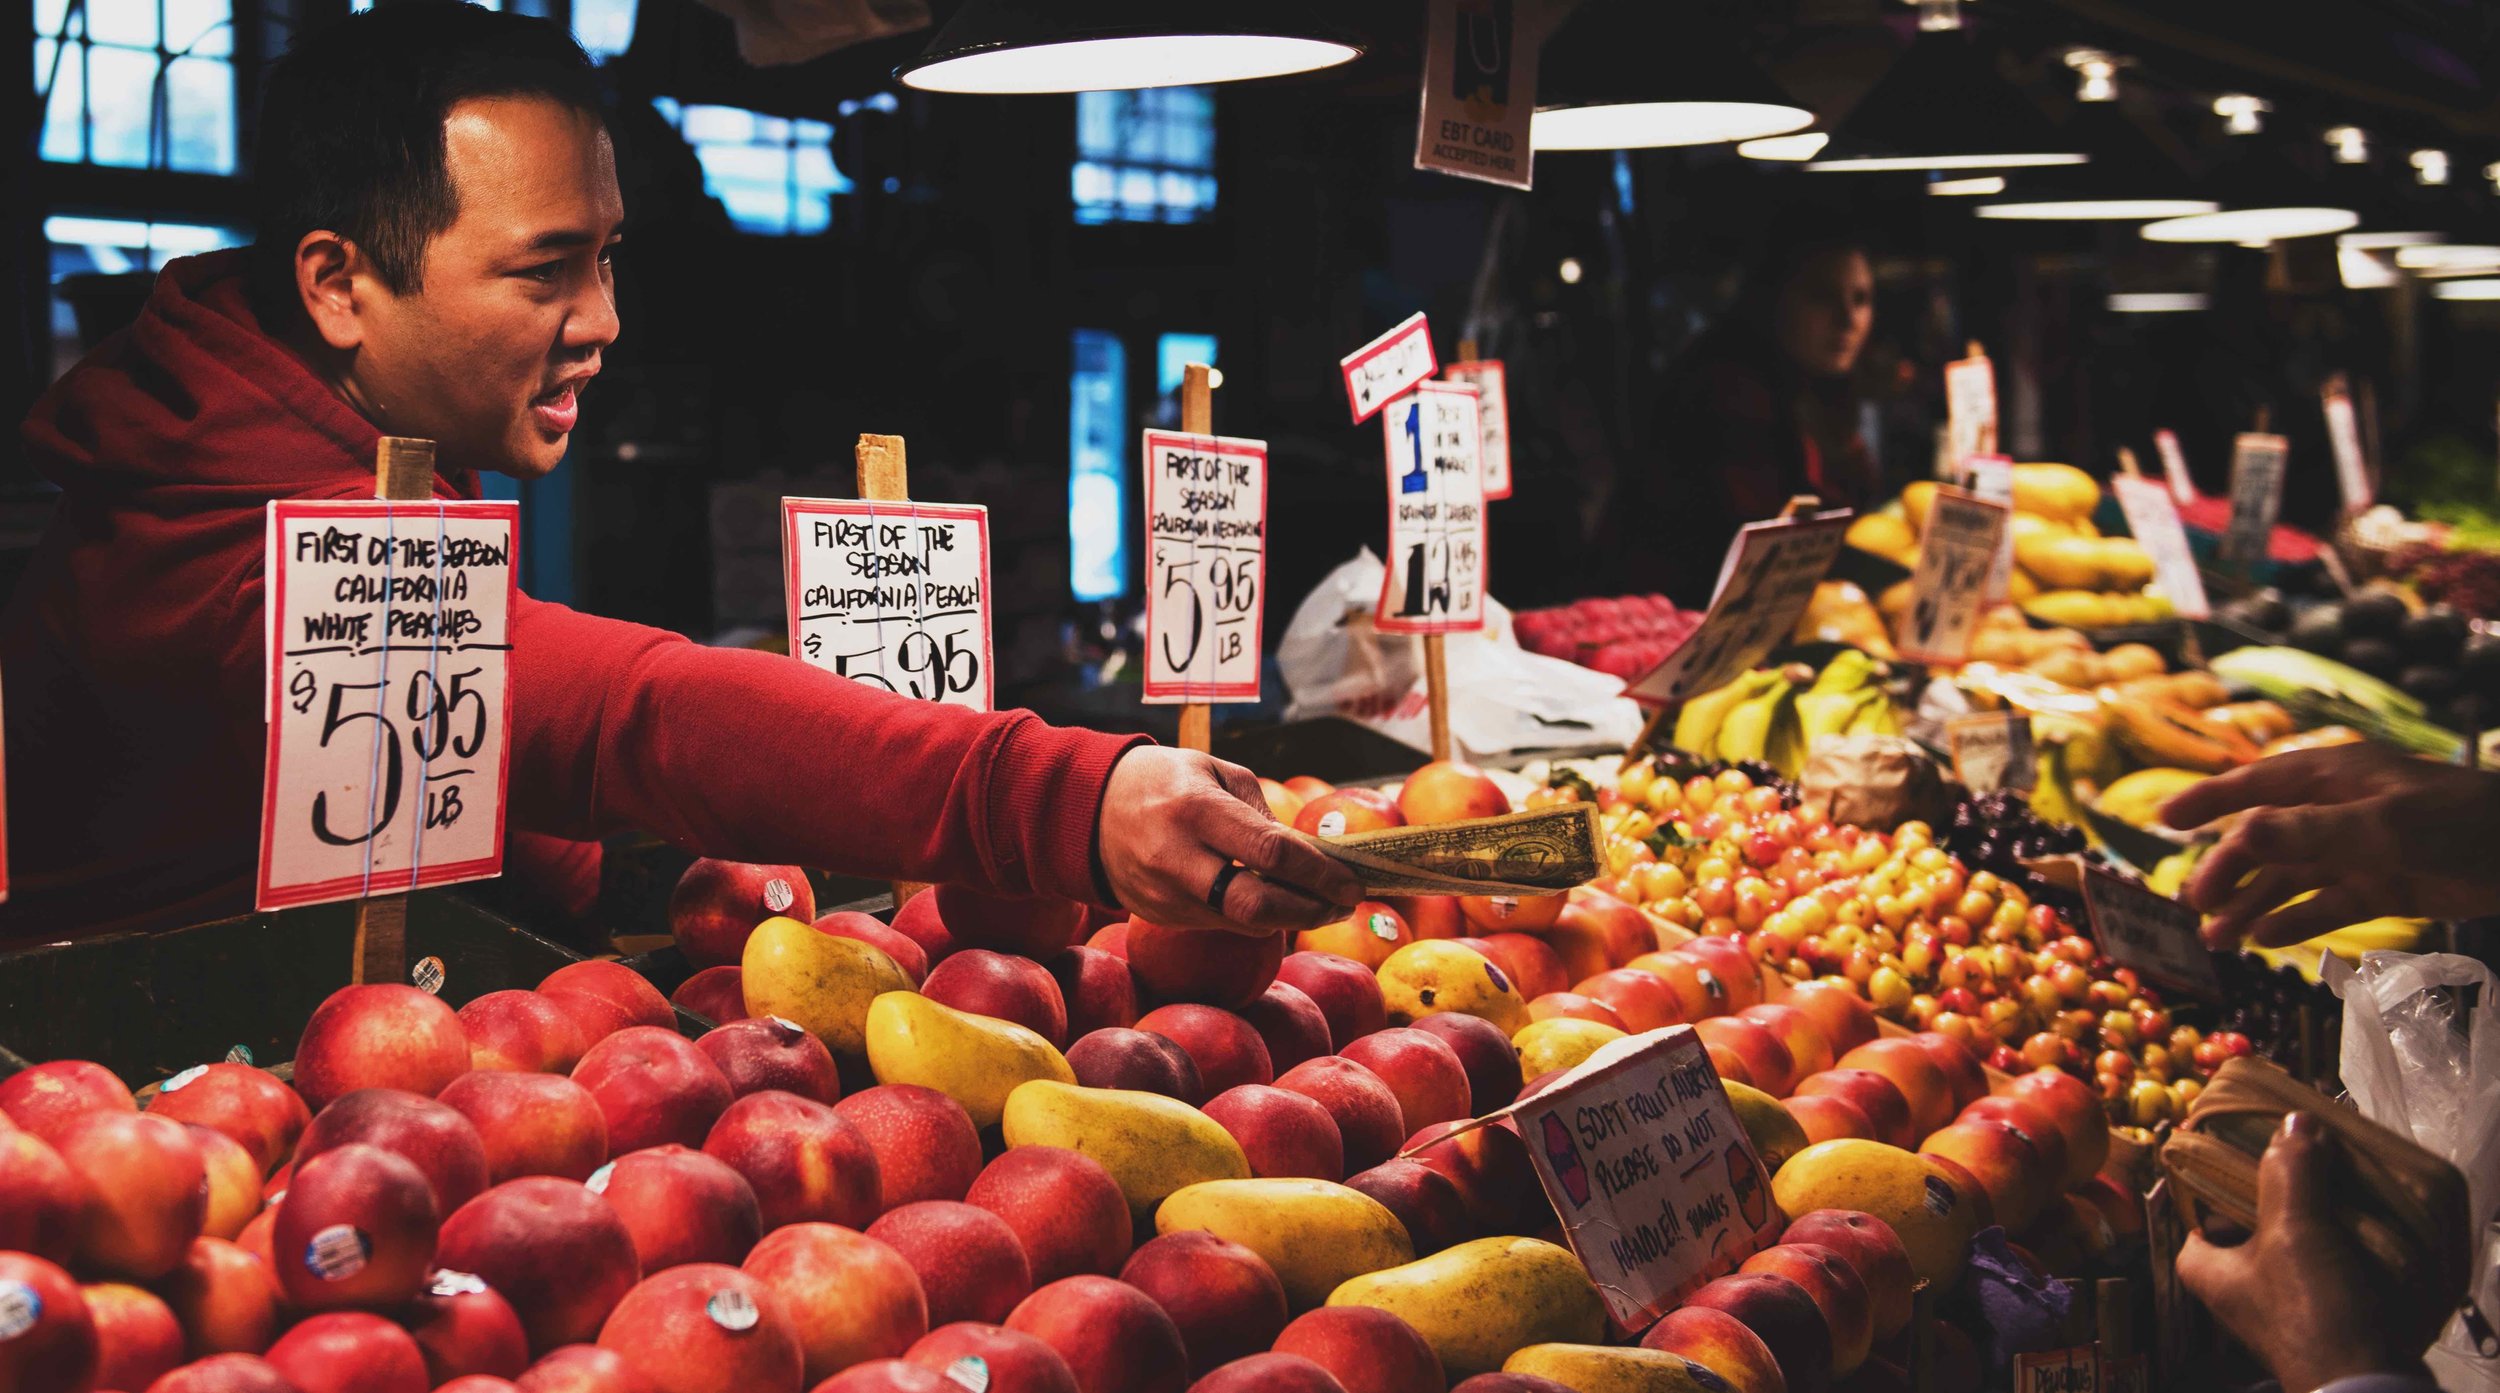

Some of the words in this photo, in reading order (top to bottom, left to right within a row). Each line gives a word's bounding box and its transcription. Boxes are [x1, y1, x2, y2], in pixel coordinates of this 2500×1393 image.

[1440, 120, 1470, 143] EBT
[1473, 126, 1513, 152] CARD
[1433, 143, 1487, 166] ACCEPTED
[1167, 452, 1203, 480] FIRST
[1205, 457, 1222, 482] OF
[1227, 462, 1249, 486] THE
[1180, 487, 1236, 514] SEASON
[297, 526, 362, 564] FIRST
[368, 537, 398, 566] OF
[399, 538, 436, 567] THE
[439, 532, 509, 568] SEASON
[815, 519, 872, 550] FIRST
[880, 523, 906, 549] OF
[919, 524, 955, 551] THE
[846, 550, 931, 579] SEASON
[334, 570, 468, 604] CALIFORNIA
[805, 583, 917, 610] CALIFORNIA
[925, 577, 980, 609] PEACH
[304, 612, 373, 647] WHITE
[387, 609, 482, 643] PEACHES
[1220, 632, 1242, 665] LB
[426, 784, 463, 829] LB
[1577, 1099, 1628, 1151] SOFT
[1626, 1079, 1675, 1124] FRUIT
[1595, 1144, 1659, 1202] PLEASE
[1662, 1133, 1682, 1158] DO
[1684, 1108, 1718, 1152] NOT
[1610, 1198, 1687, 1277] HANDLE!!
[1686, 1193, 1730, 1240] THANKS
